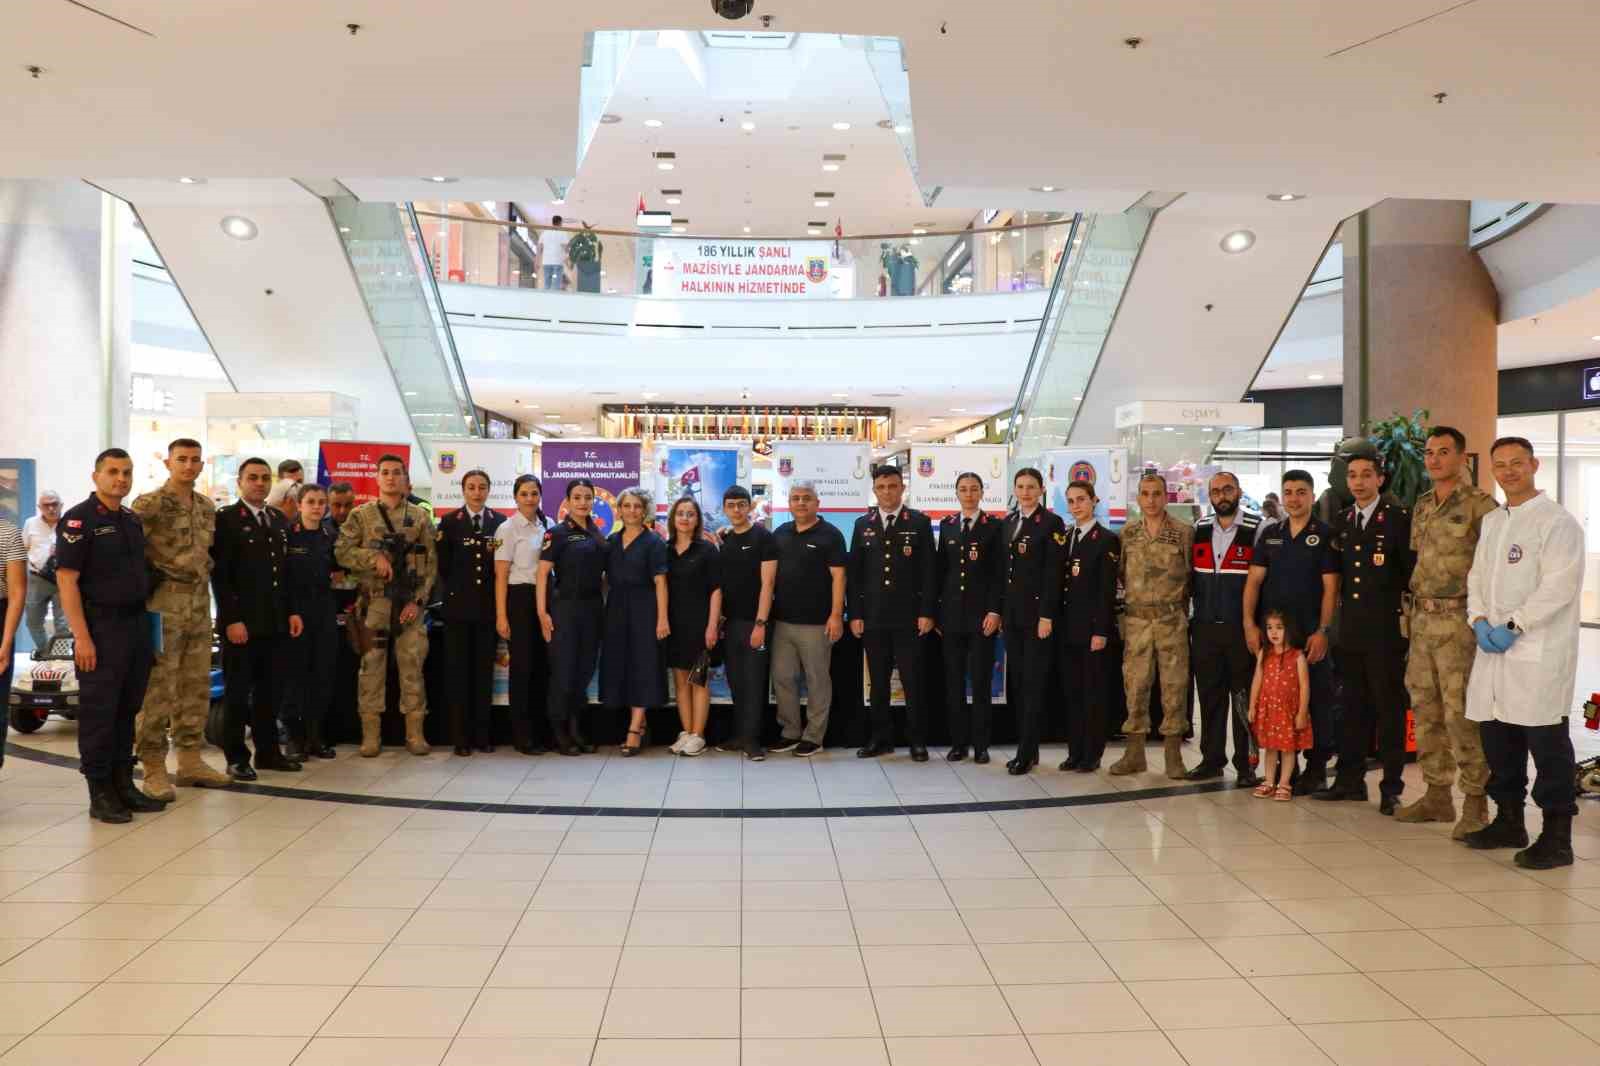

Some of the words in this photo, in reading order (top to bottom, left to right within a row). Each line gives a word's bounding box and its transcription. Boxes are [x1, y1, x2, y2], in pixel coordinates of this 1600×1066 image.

[697, 245, 717, 257] 186
[720, 245, 755, 257] YILLIK
[759, 246, 791, 260] ŞANLI
[682, 260, 741, 275] MAZİSİYLE
[745, 263, 804, 276] JANDARMA
[681, 281, 735, 292] HALKININ
[738, 280, 806, 293] HİZMETİNDE
